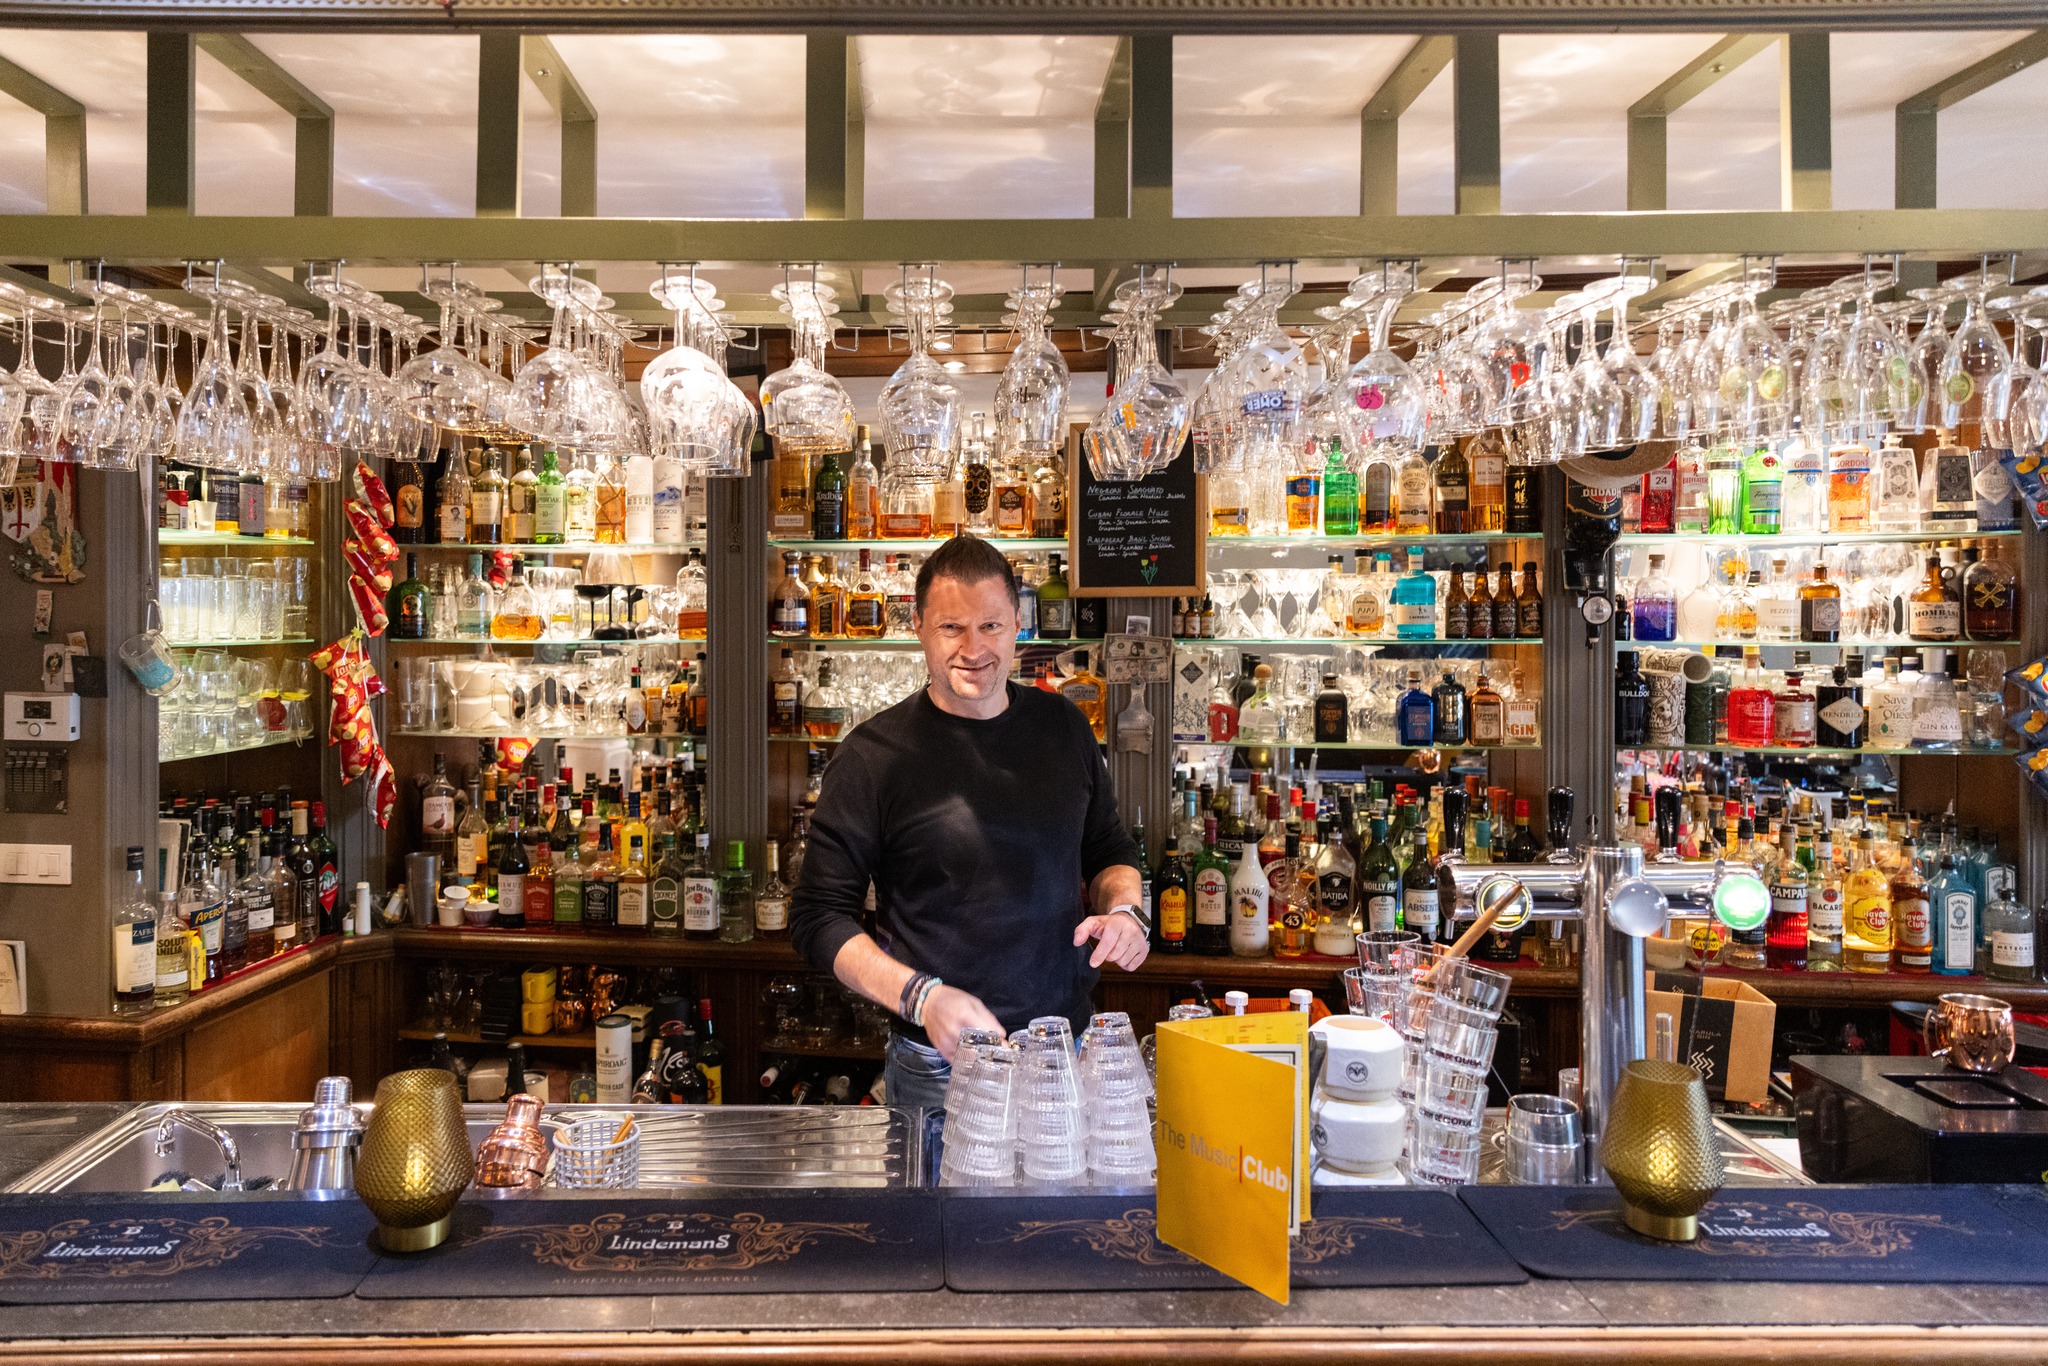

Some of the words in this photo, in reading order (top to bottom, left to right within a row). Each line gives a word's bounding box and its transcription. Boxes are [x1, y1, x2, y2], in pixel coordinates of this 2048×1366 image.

[1655, 476, 1668, 485] 24
[1356, 607, 1375, 615] 1919
[1883, 694, 1908, 706] Save
[1883, 709, 1911, 721] Quee
[1919, 721, 1938, 730] GIN
[1219, 841, 1244, 849] RICA
[685, 884, 696, 895] JIM
[695, 883, 713, 896] BEAM
[1195, 883, 1227, 893] MARTINI
[1363, 881, 1386, 891] NOILLY
[1234, 887, 1265, 900] MALIBU
[1321, 891, 1349, 901] BATIDA
[686, 908, 710, 916] BOURBON
[1407, 903, 1439, 913] ABSENT
[195, 908, 224, 924] APERO
[1284, 916, 1300, 927] 43
[1869, 918, 1887, 926] Club
[1907, 920, 1925, 929] Club
[597, 1057, 627, 1068] PHROAIG
[1454, 1054, 1483, 1068] CUBA
[1159, 1118, 1186, 1150] The
[1189, 1131, 1238, 1172] Music
[1243, 1154, 1289, 1193] Club
